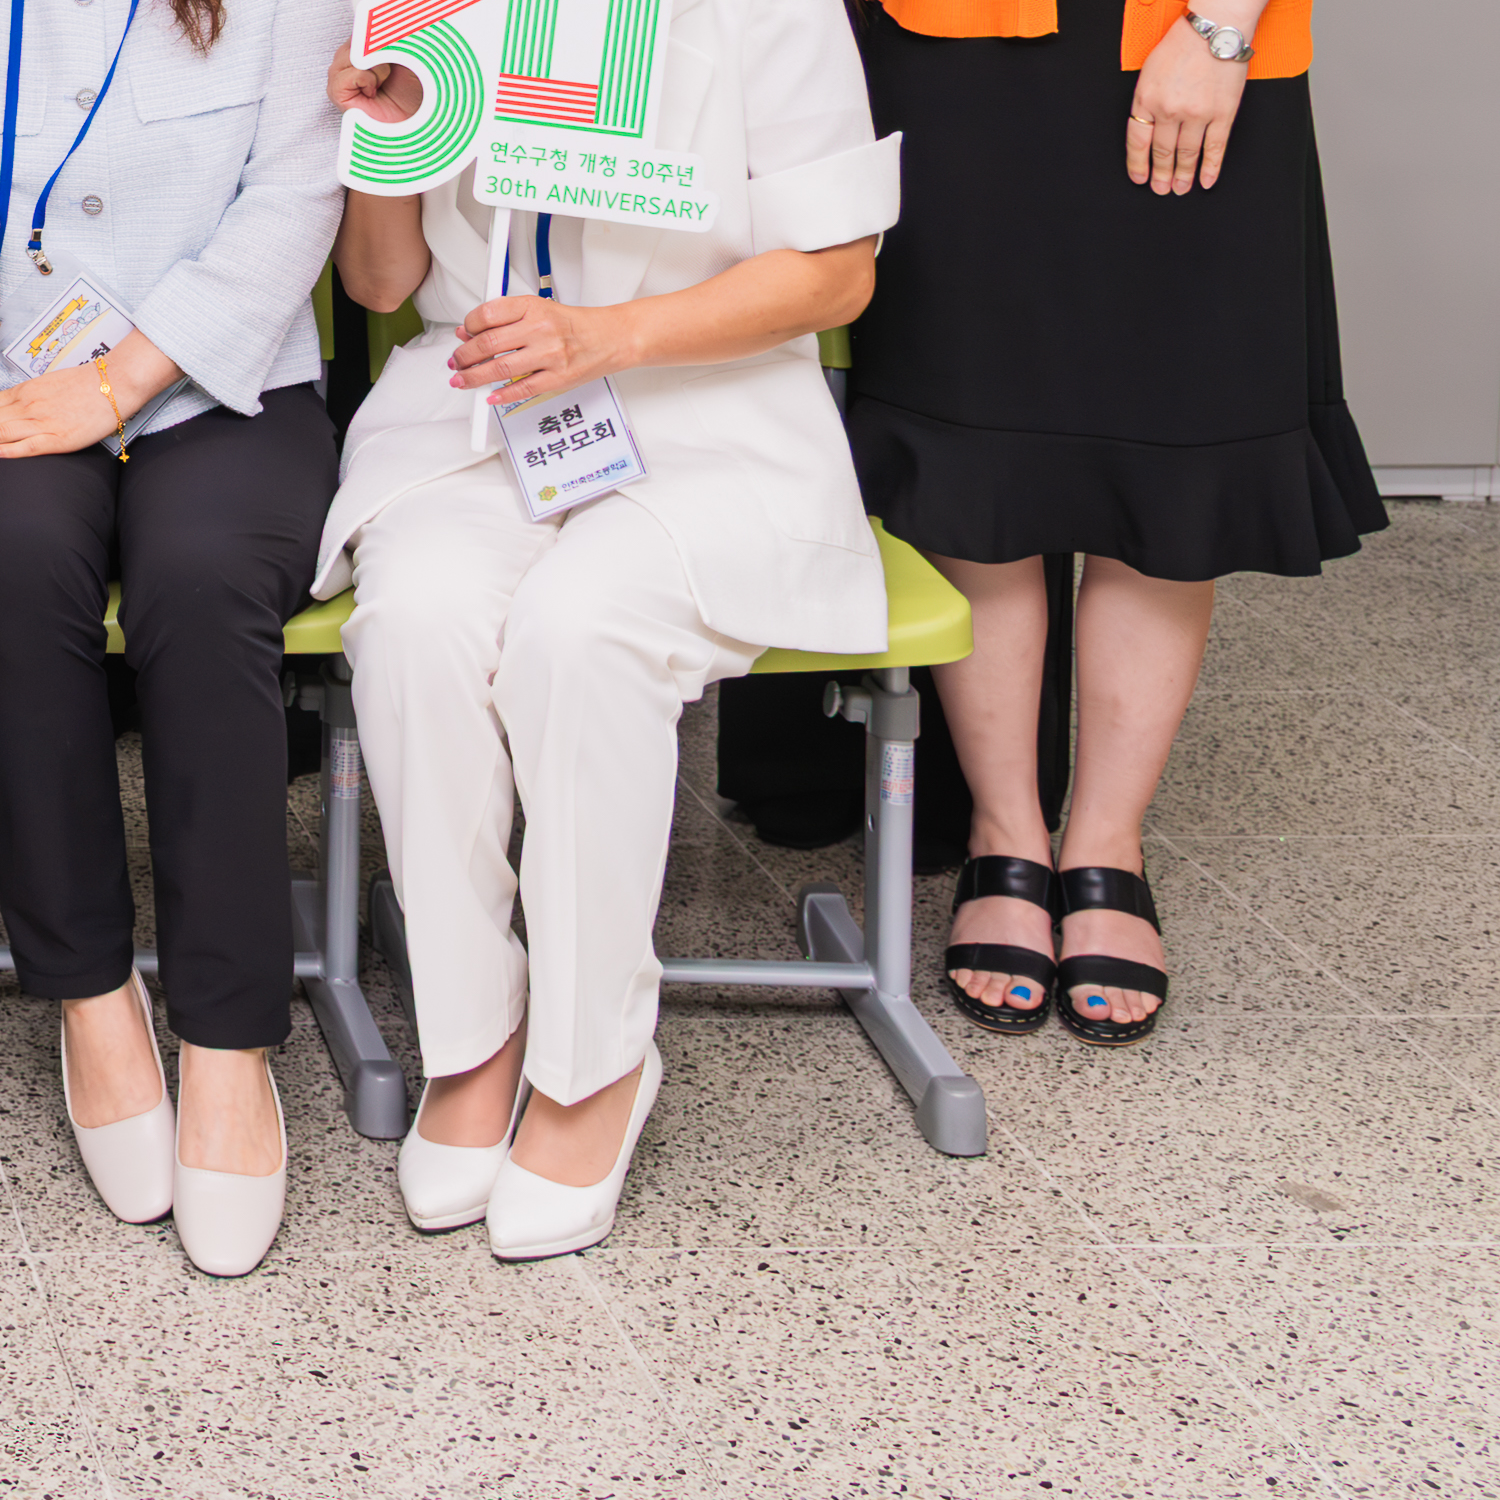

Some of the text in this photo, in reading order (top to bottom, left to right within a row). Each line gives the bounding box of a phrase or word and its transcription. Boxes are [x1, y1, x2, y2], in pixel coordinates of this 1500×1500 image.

[490, 141, 695, 188] 연수구청 개청 30주년
[485, 175, 709, 222] 30th ANNIVERSARY
[537, 403, 585, 435] 축현
[523, 417, 617, 469] 학부모회
